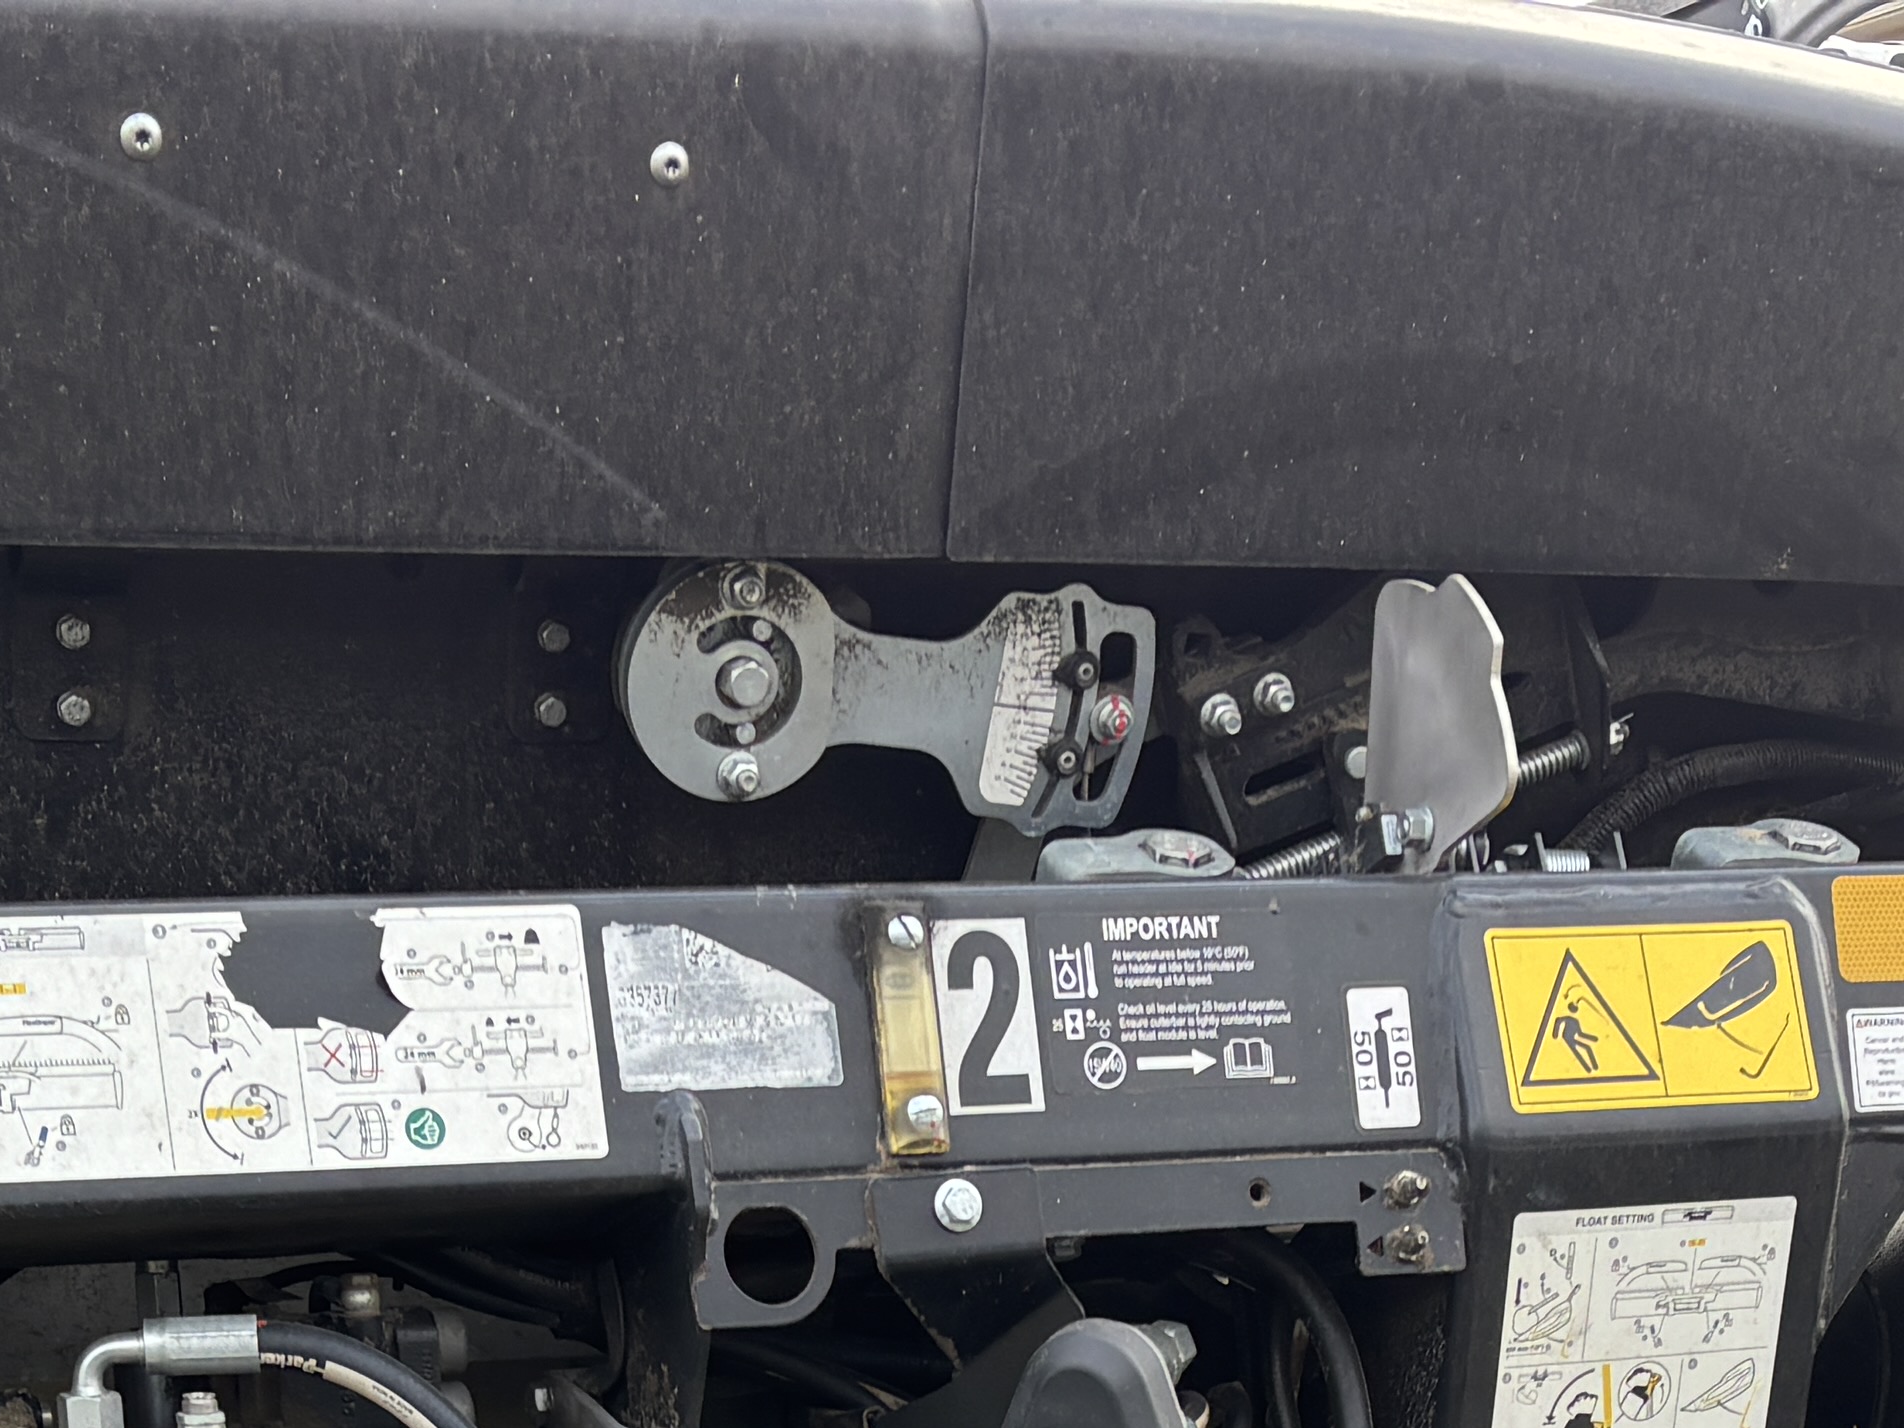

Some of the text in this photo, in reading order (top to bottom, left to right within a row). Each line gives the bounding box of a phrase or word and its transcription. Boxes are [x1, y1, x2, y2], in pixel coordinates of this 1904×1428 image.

[1102, 915, 1220, 941] IMPORTANT
[1118, 1002, 1144, 1015] Check
[1146, 1002, 1156, 1014] oil
[1157, 1002, 1176, 1014] level
[1177, 1002, 1200, 1016] every
[1214, 1000, 1237, 1012] hours
[946, 930, 1032, 1110] 2
[1119, 1017, 1148, 1029] Ensure
[1221, 1013, 1262, 1027] contacting
[1263, 1012, 1292, 1026] ground
[1120, 1031, 1137, 1042] and
[1354, 1031, 1372, 1067] 50
[1394, 1051, 1414, 1088] 50
[1576, 1212, 1655, 1228] FLOAT SETTING
[261, 1352, 317, 1374] Parker
